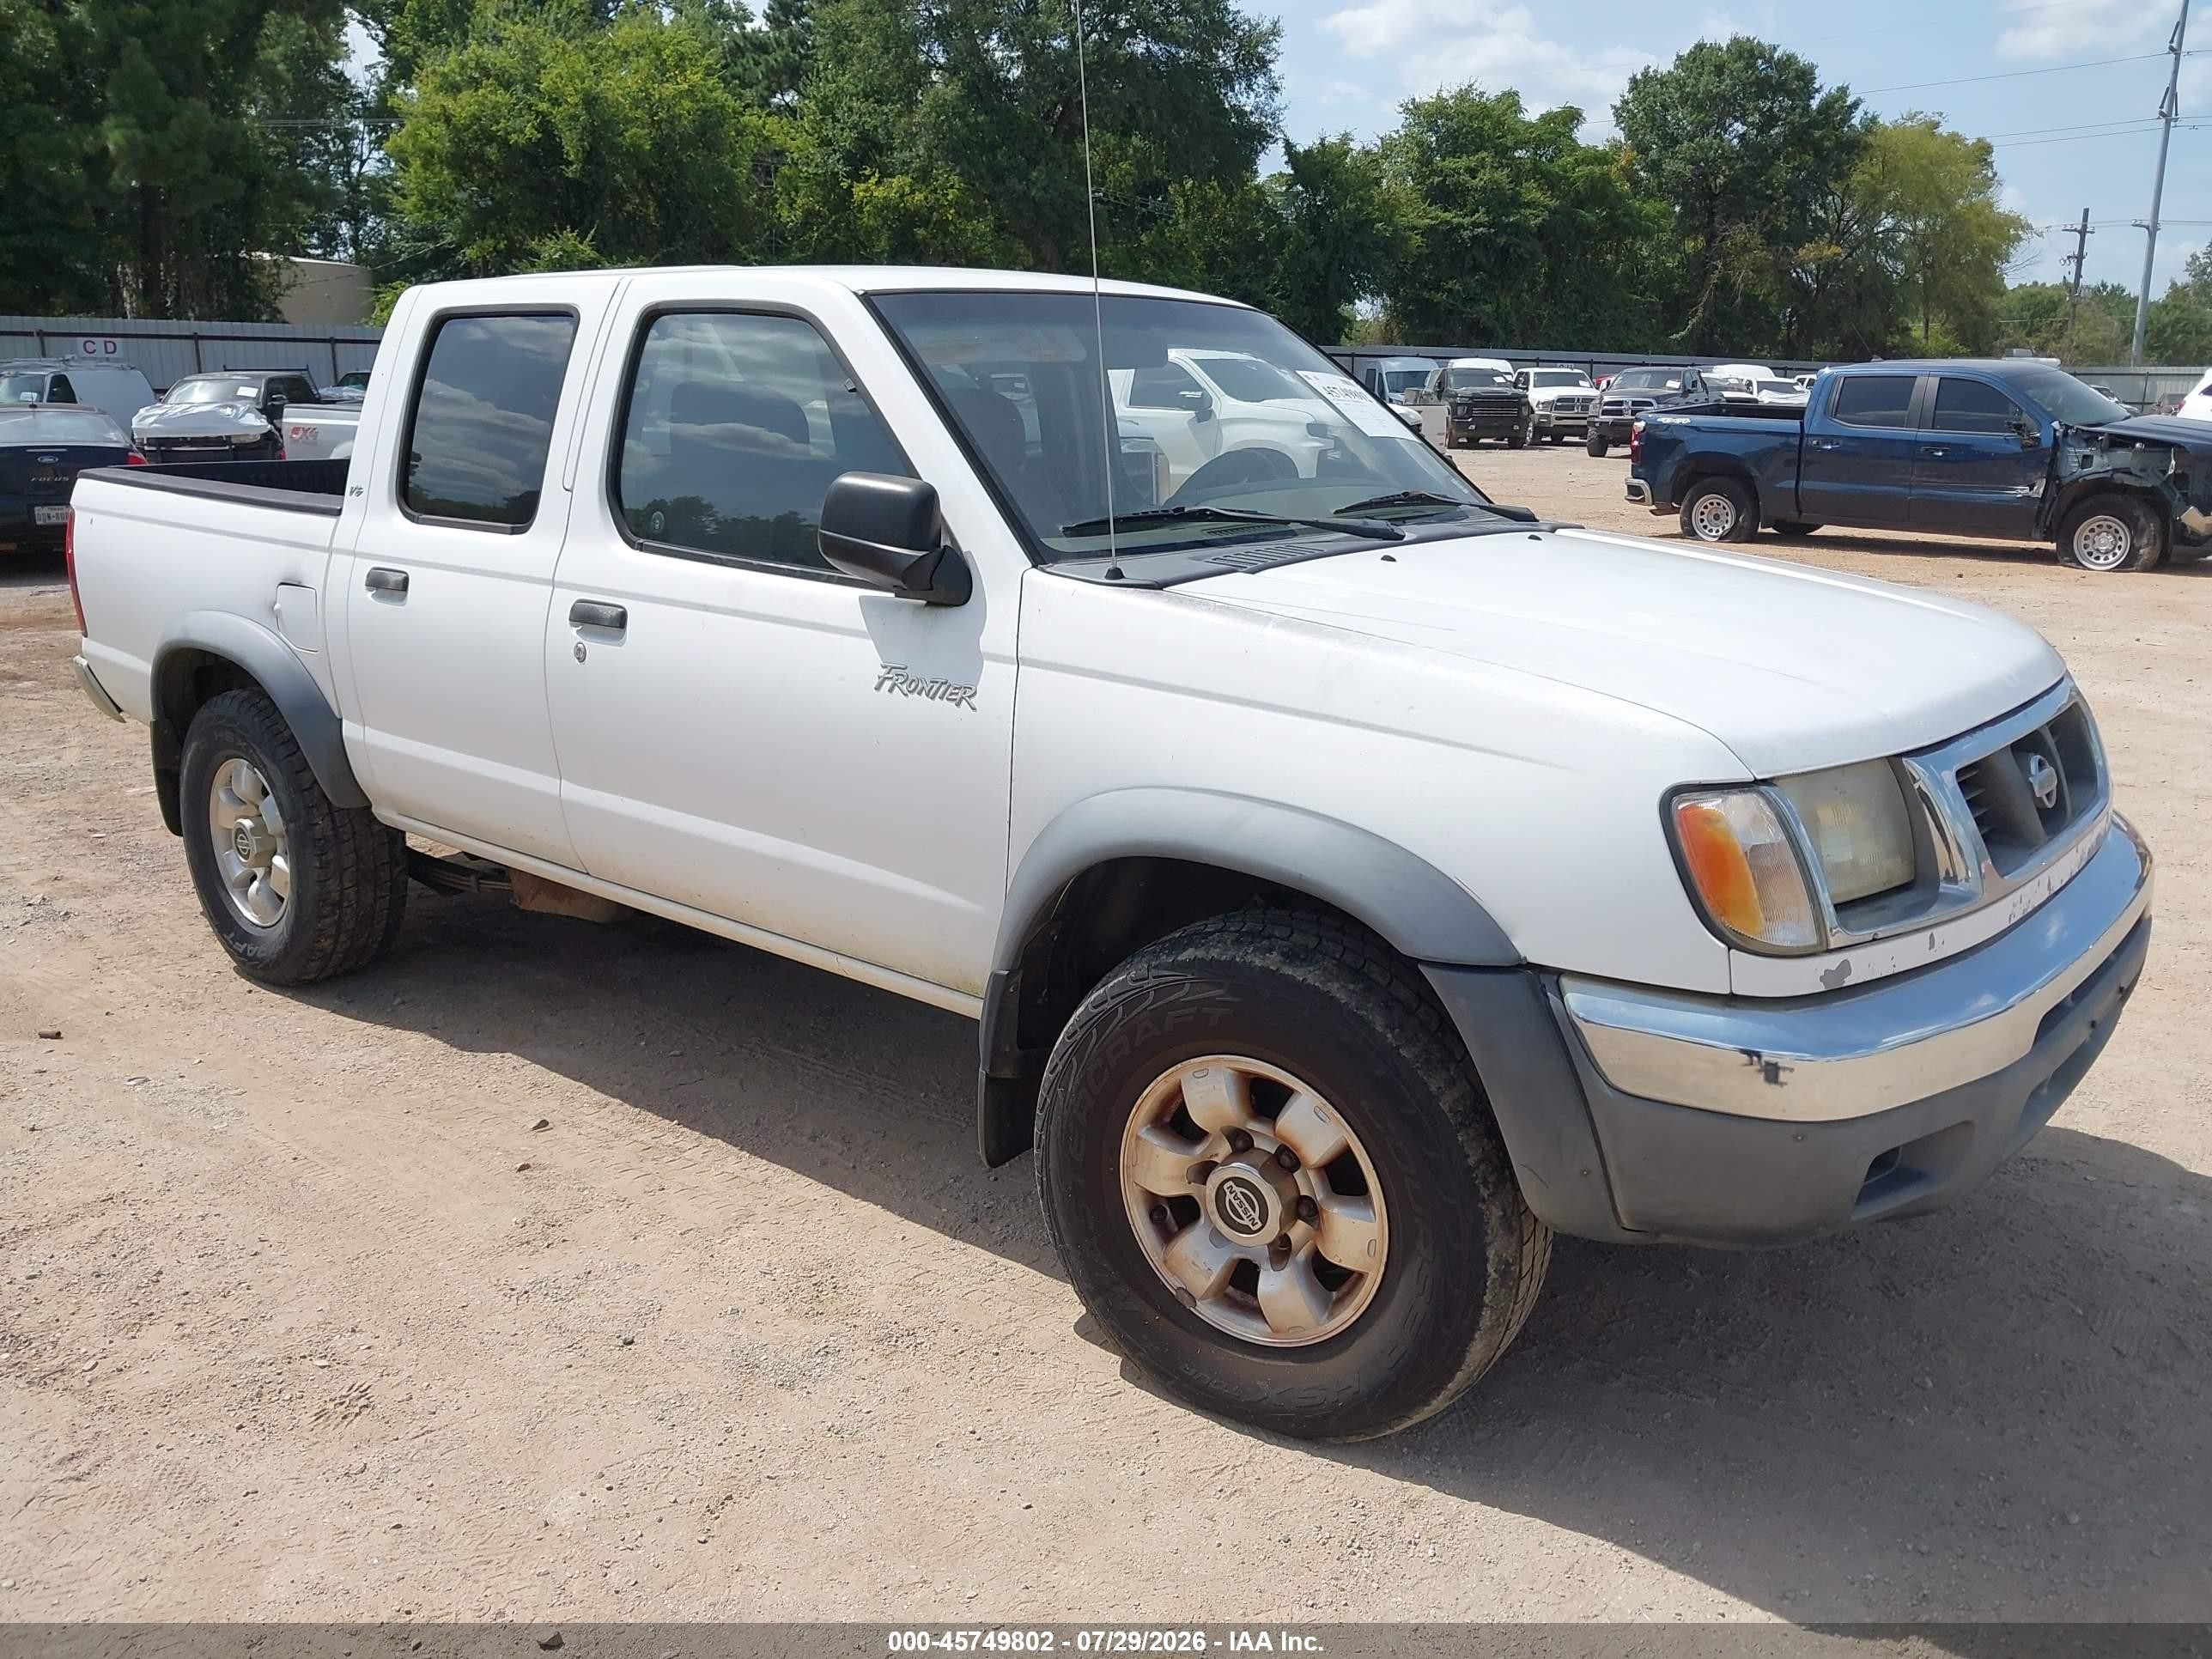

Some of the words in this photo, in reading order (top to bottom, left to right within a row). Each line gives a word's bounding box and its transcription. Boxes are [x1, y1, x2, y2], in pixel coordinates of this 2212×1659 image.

[83, 340, 97, 355] C
[104, 340, 118, 355] D
[349, 485, 364, 498] V6
[873, 662, 978, 712] FRONTIER
[1226, 1184, 1259, 1227] NISSAN
